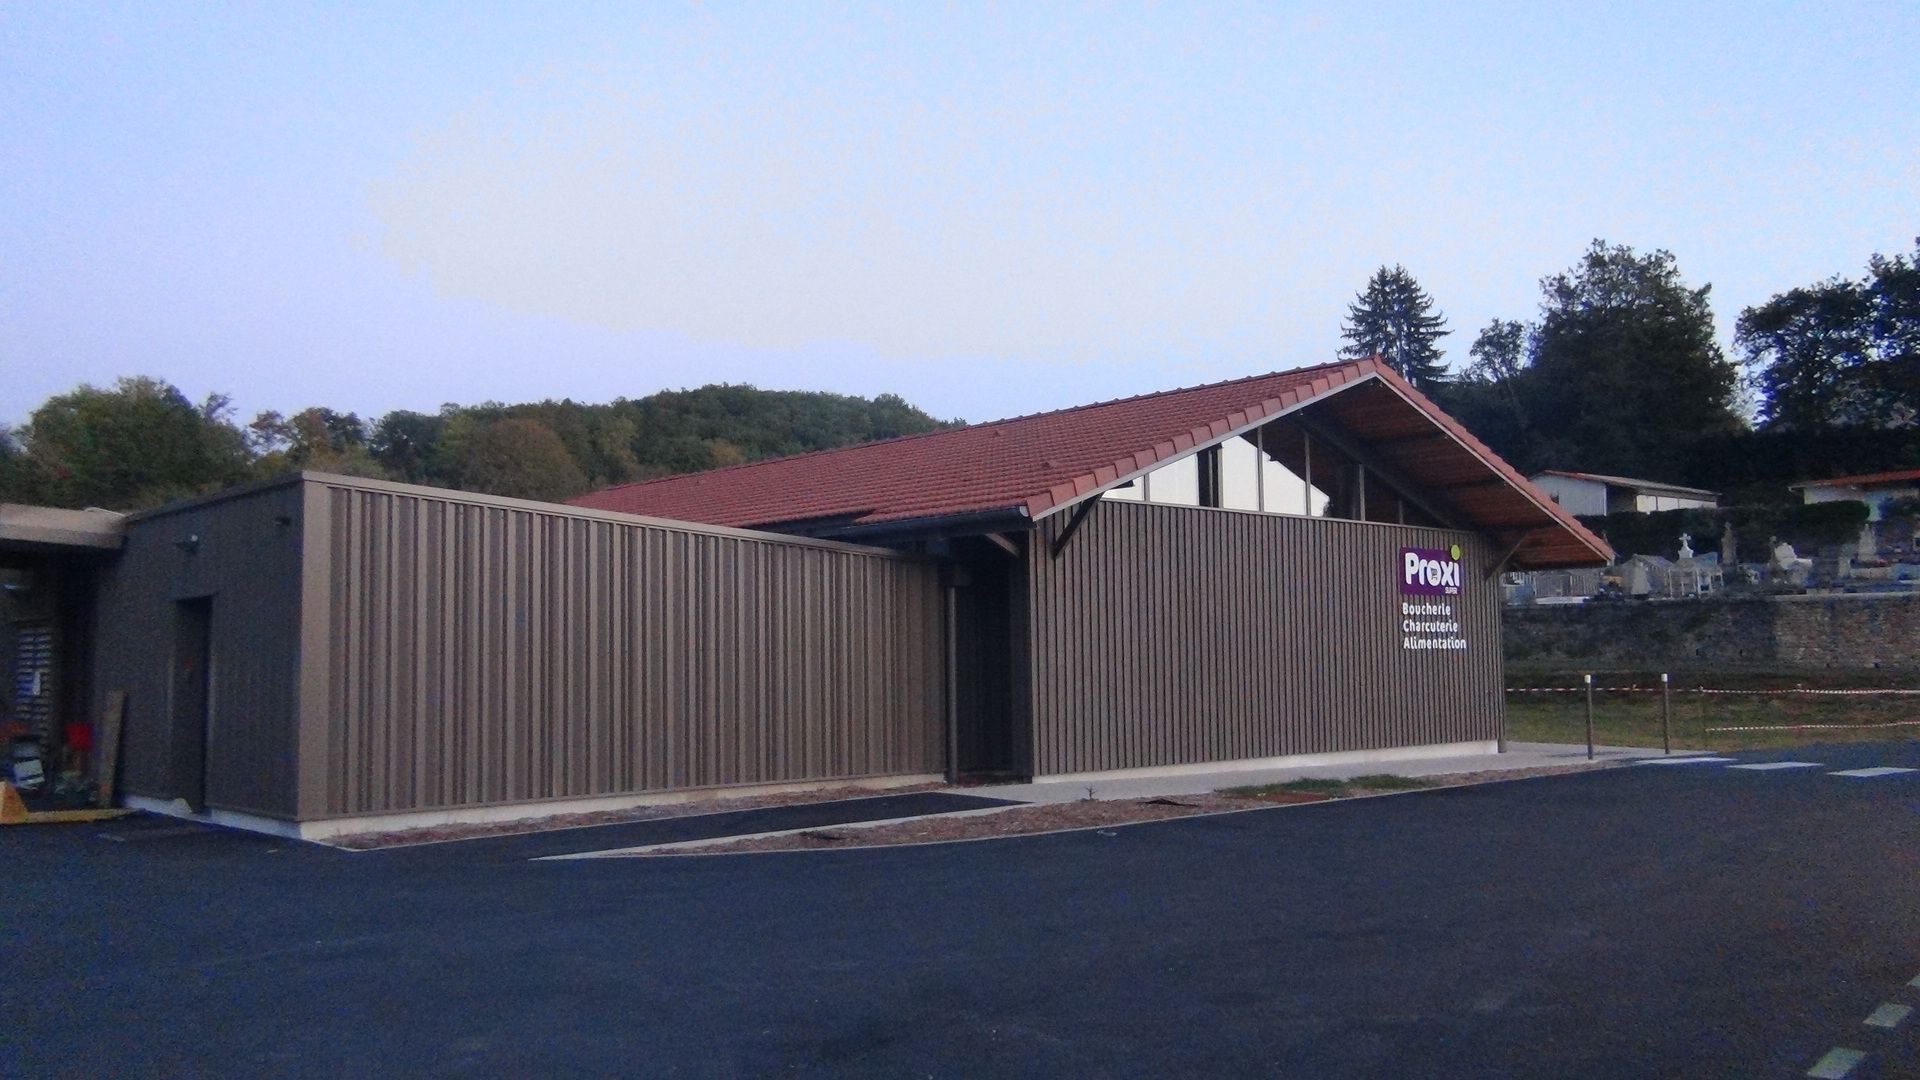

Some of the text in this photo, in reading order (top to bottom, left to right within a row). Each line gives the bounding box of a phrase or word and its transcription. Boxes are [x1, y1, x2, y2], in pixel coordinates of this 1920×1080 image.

[1405, 545, 1460, 586] Proxi
[1402, 602, 1451, 615] Boucherie
[1403, 620, 1458, 632] Charcuterie
[1403, 637, 1467, 649] Alimentation
